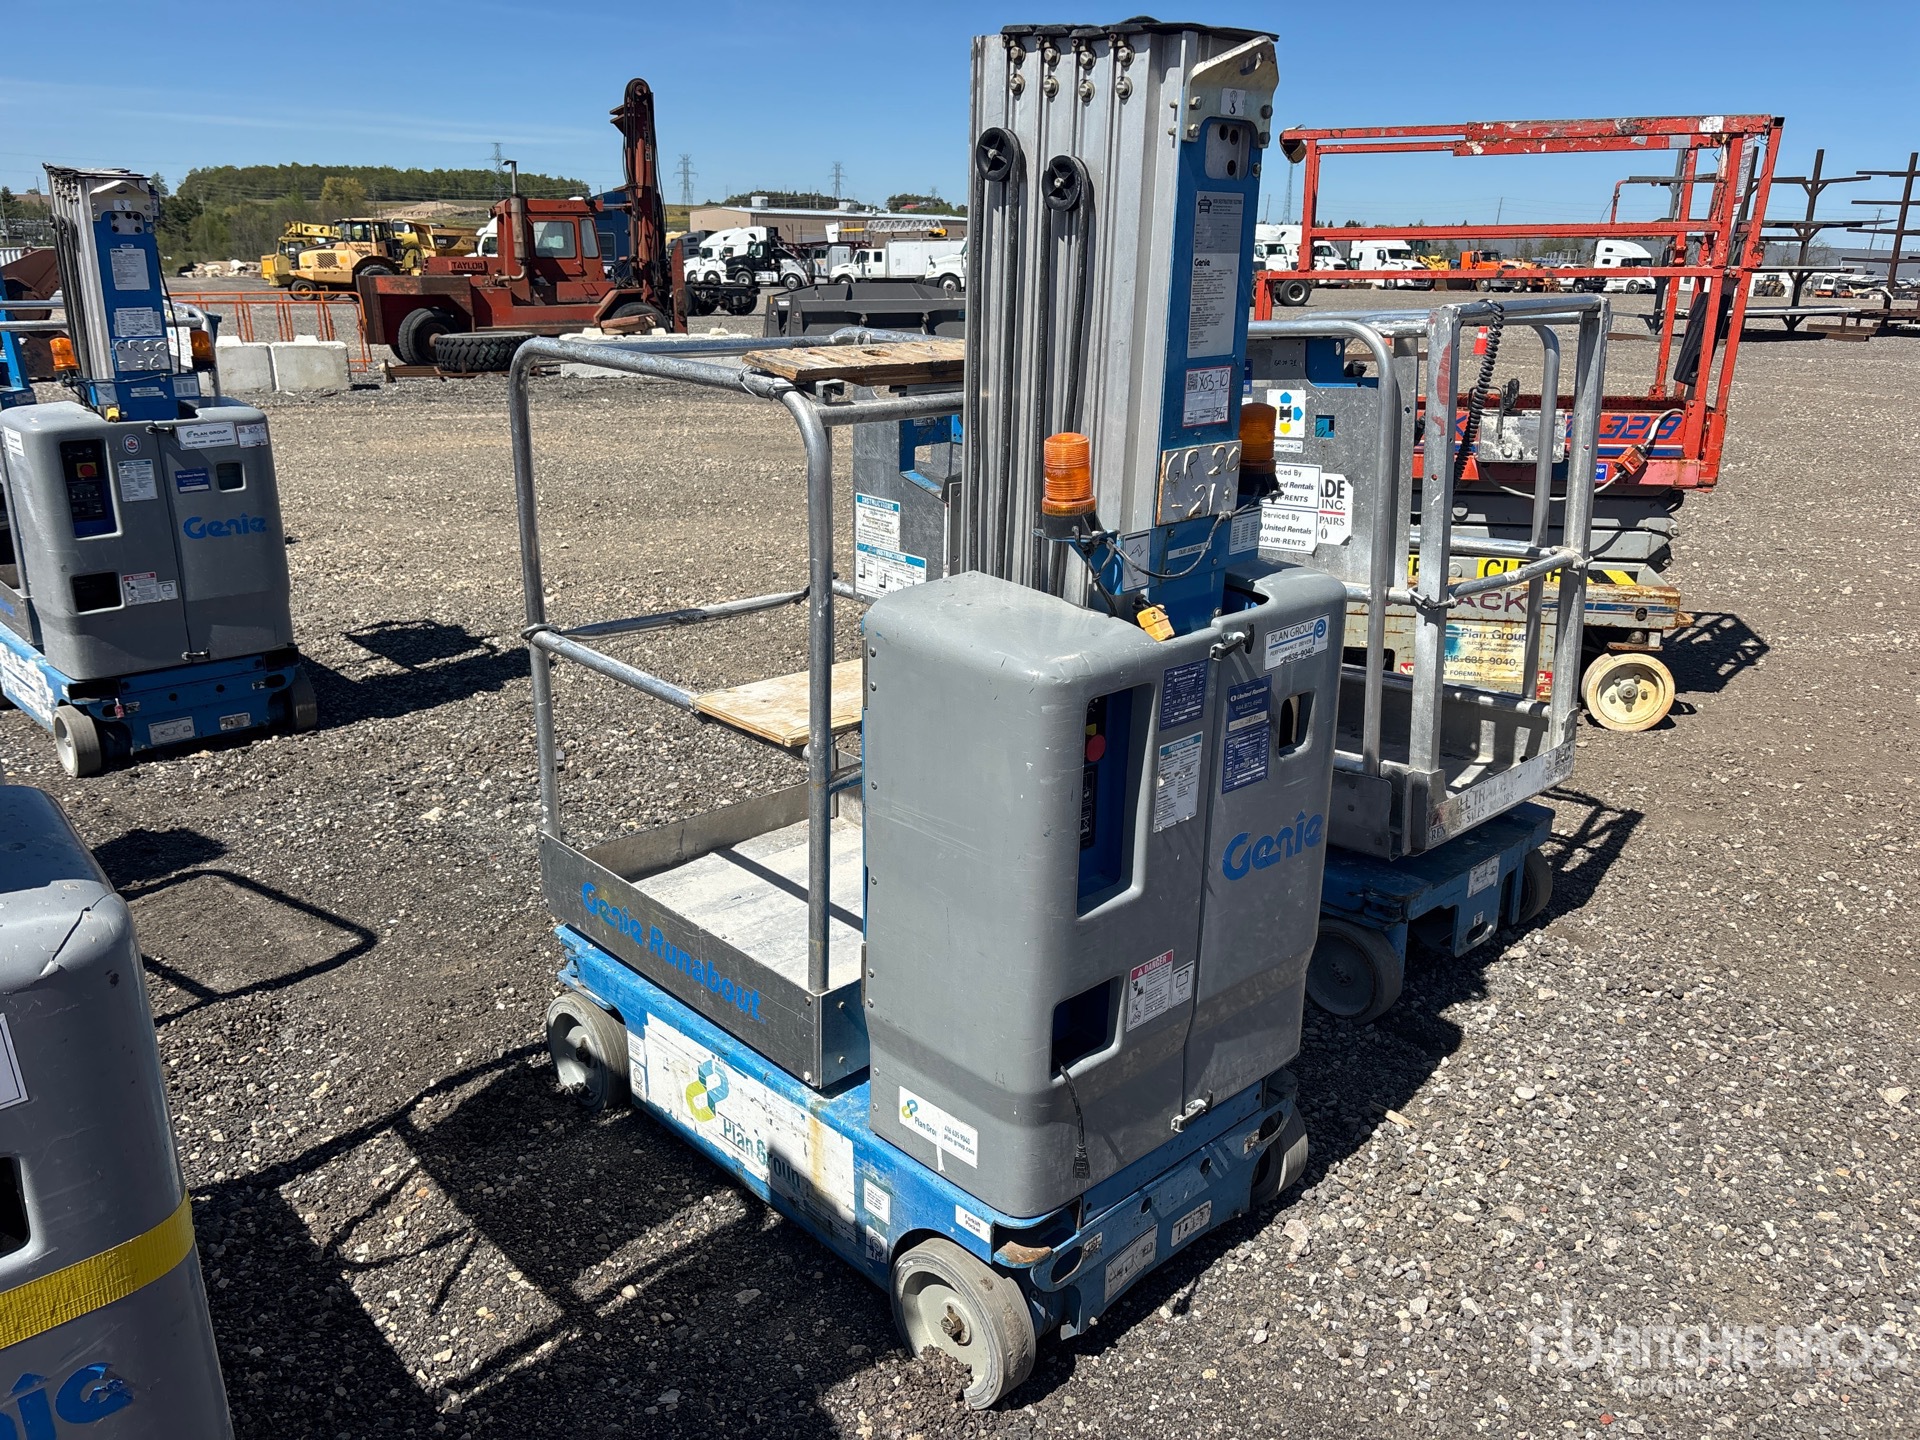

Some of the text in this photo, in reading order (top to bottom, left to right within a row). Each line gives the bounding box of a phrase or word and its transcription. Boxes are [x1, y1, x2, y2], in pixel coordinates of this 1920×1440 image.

[451, 261, 484, 271] TAYLOR
[1194, 258, 1211, 267] Genie
[1294, 469, 1302, 477] By
[1289, 481, 1314, 491] Rentals
[1321, 498, 1346, 511] INC.
[1263, 511, 1300, 522] Serviced By
[1319, 515, 1345, 527] PAIRS
[184, 512, 267, 540] Genie
[1264, 523, 1287, 532] United
[1287, 525, 1313, 535] Rentals
[1270, 622, 1315, 645] PLAN GROUP
[1450, 669, 1482, 677] FOREMAN
[1222, 810, 1324, 881] Genie
[581, 881, 762, 1021] Genie Runabout
[1144, 955, 1167, 974] DANGER
[914, 1116, 926, 1130] Plan
